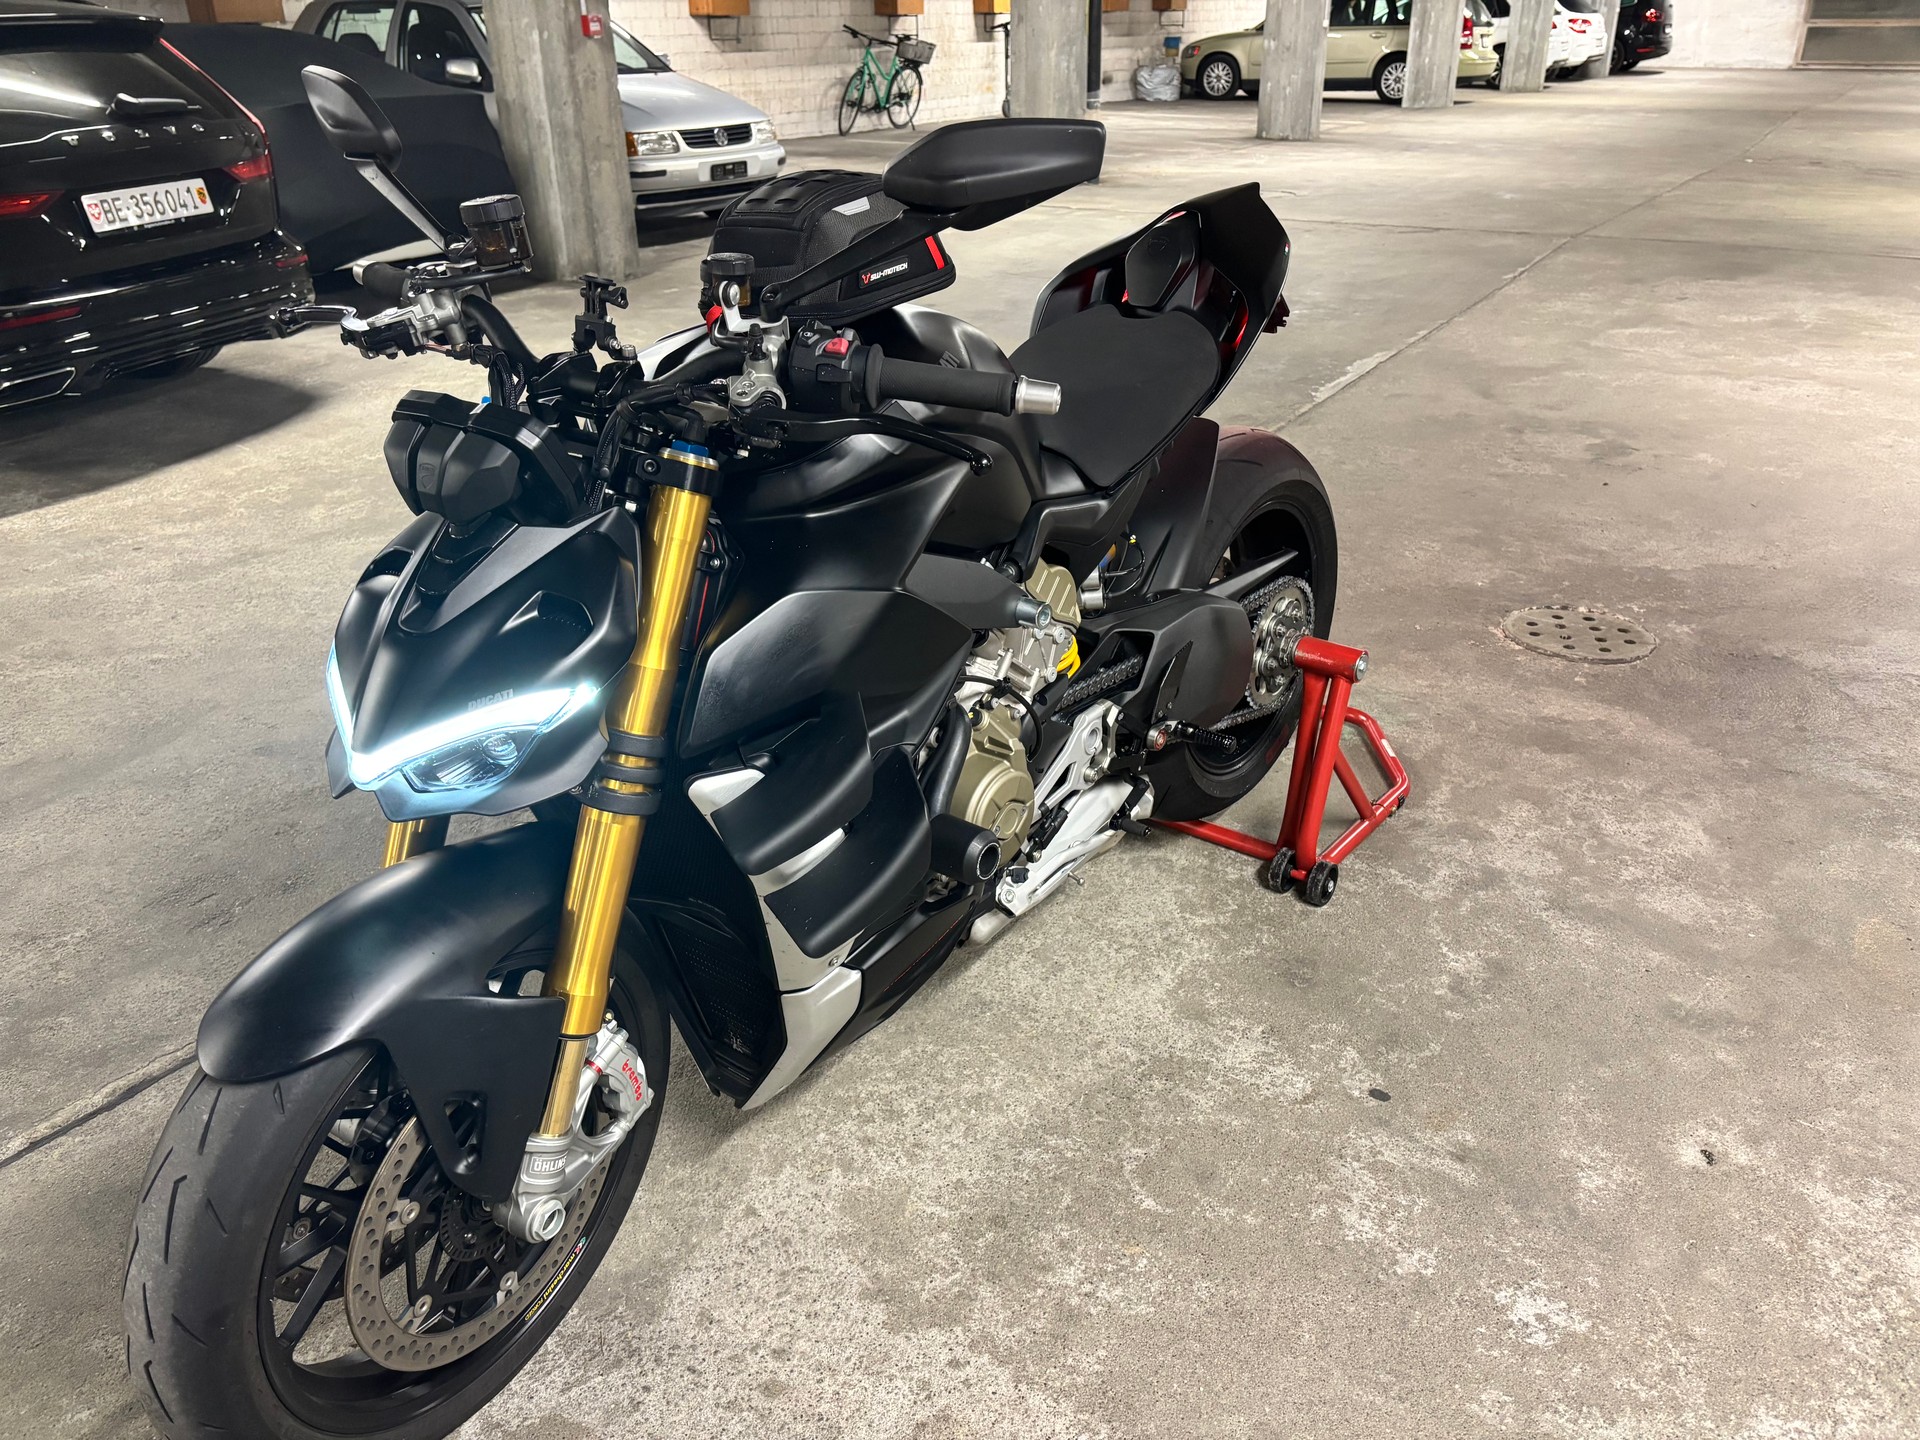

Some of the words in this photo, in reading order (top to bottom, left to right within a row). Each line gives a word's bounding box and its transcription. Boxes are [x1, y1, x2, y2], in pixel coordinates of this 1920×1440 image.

[870, 262, 908, 281] SW-MOTECH
[468, 689, 514, 711] DUCATI
[622, 1058, 643, 1101] brembo
[543, 1253, 576, 1299] marchesini
[525, 1298, 544, 1320] FORGED
